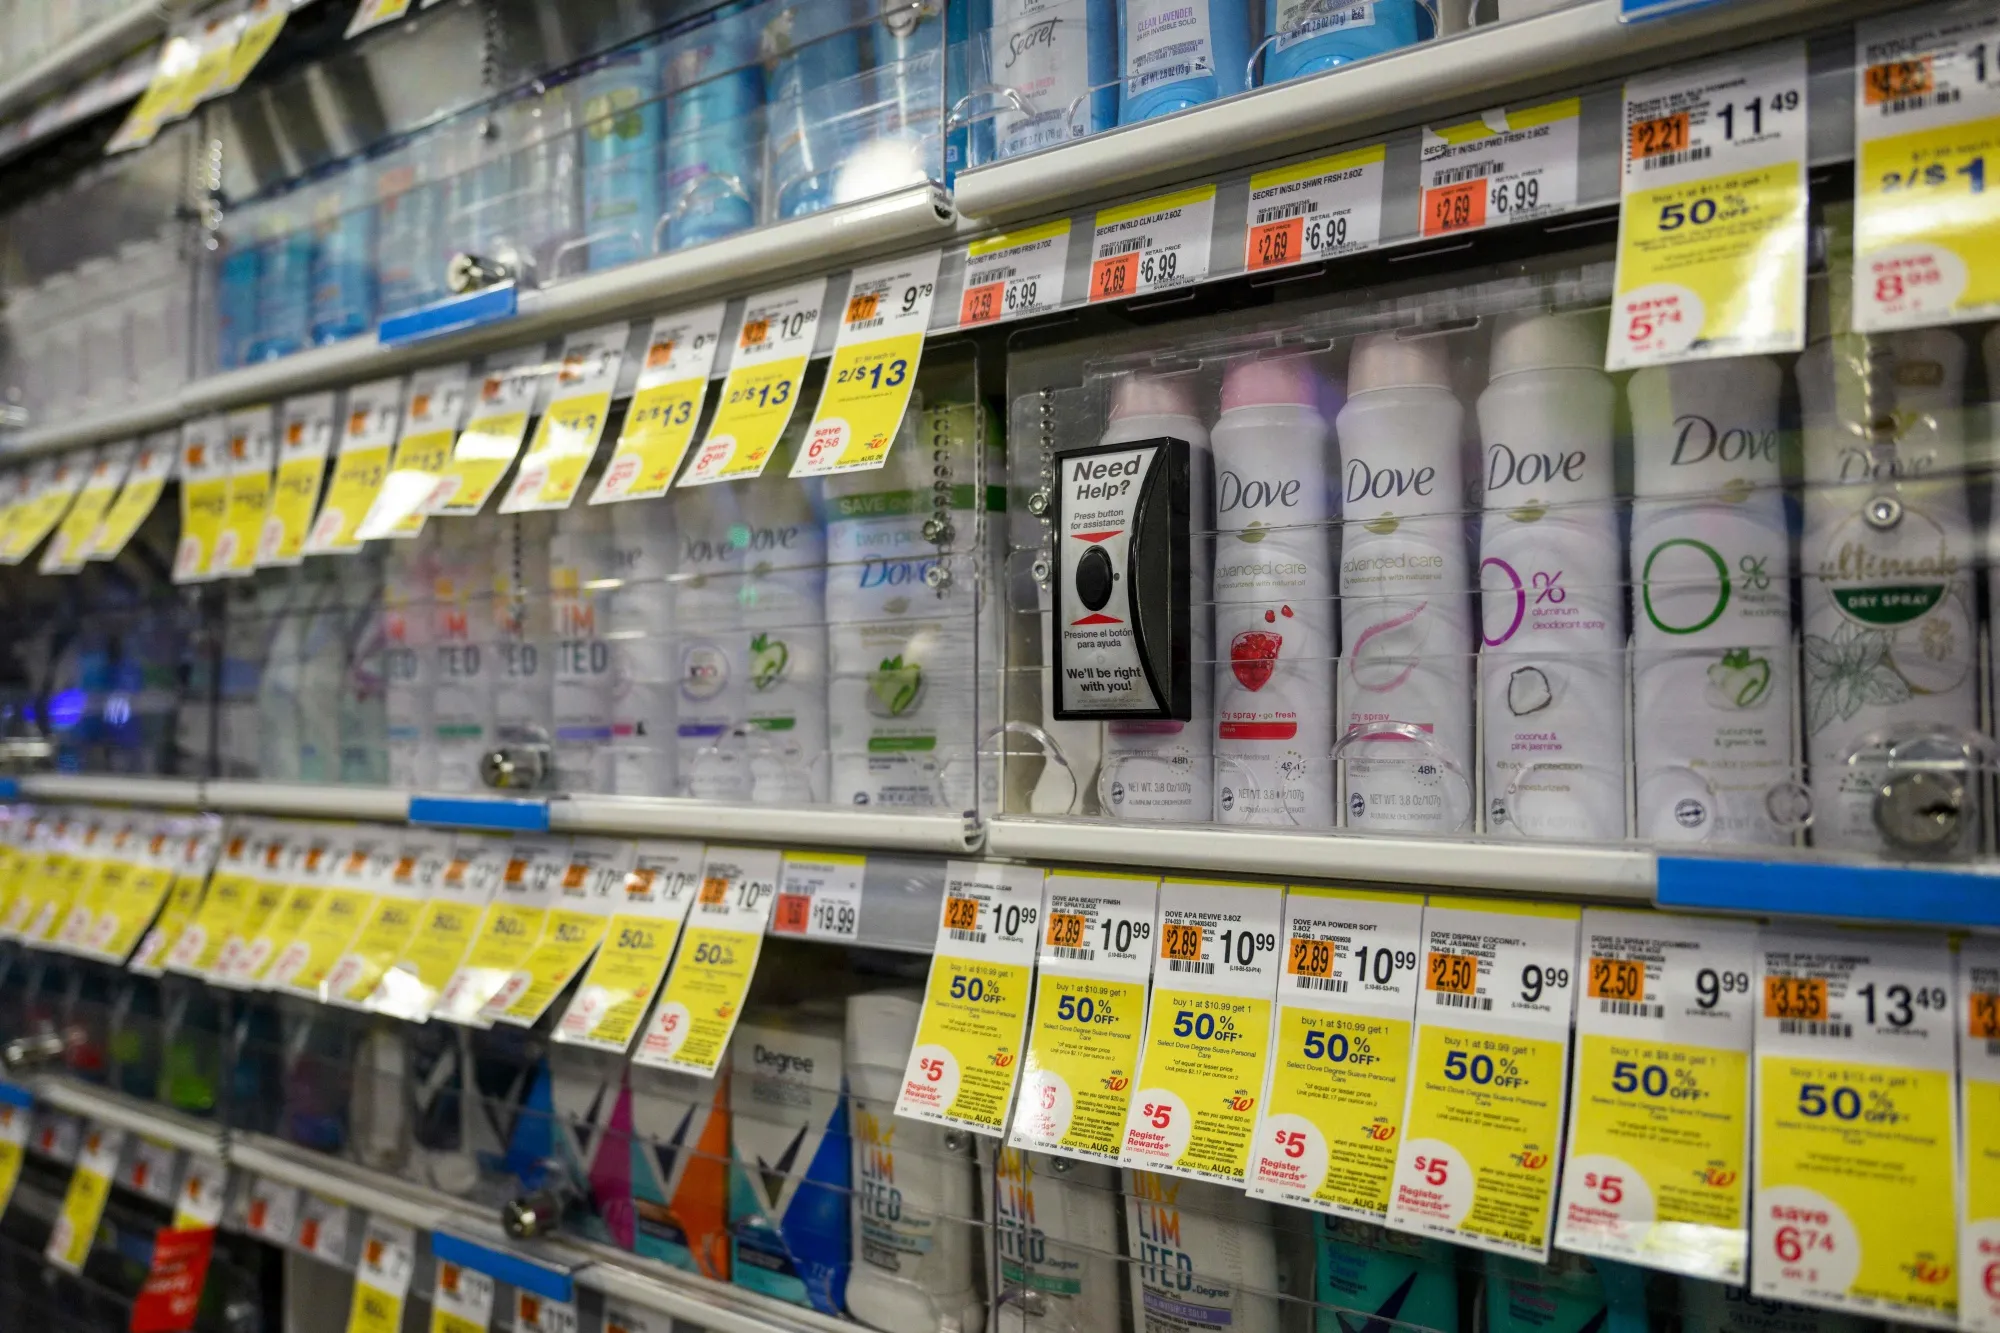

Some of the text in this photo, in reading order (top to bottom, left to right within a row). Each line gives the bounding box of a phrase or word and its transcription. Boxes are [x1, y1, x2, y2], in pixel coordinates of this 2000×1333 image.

[1138, 7, 1193, 33] CLEAN LAVENDER
[1151, 18, 1197, 36] INVISIBLE SOLID
[1252, 169, 1362, 201] SECRET IN/SLD SHWR FRSH 2.6OZ
[1491, 178, 1538, 214] $6.99
[1437, 195, 1469, 229] $2.69
[1096, 209, 1182, 237] SECRET IN/SLD CLN LAV 2.6OZ
[1306, 217, 1346, 251] $6.99
[1259, 231, 1287, 261] $2.69
[1141, 252, 1176, 283] $6.99
[1100, 265, 1126, 293] $2.69
[1005, 282, 1037, 310] $6.99
[814, 426, 841, 437] save
[1671, 413, 1778, 466] Dove
[861, 455, 875, 463] AUG
[1073, 455, 1141, 482] Need
[1488, 443, 1586, 491] Dove
[1076, 480, 1130, 501] Help?
[1347, 459, 1435, 503] Dove
[1220, 471, 1301, 513] Dove
[839, 498, 885, 515] SAVE
[1098, 509, 1123, 517] button
[1083, 519, 1125, 528] assistance
[1216, 561, 1307, 578] advanced care
[1343, 554, 1442, 573] advanced care
[1848, 593, 1929, 608] DRY SPRAY
[1064, 631, 1098, 639] Presione
[1109, 628, 1133, 637] botón
[1077, 640, 1121, 649] para ayuda
[1066, 667, 1141, 679] We'll be right
[1081, 682, 1132, 693] with you!
[1233, 712, 1256, 721] spray
[1172, 756, 1188, 764] 48h
[1418, 765, 1436, 775] 48h
[814, 903, 855, 934] $19.99
[949, 901, 974, 926] $2.89
[1053, 918, 1080, 943] $2.89
[1328, 921, 1357, 929] POWDER
[1167, 929, 1197, 957] $2.89
[1431, 931, 1520, 946] DOVE DSPRAY COCONUT
[1449, 940, 1479, 948] JASMINE
[1295, 945, 1328, 973] $2.89
[1432, 958, 1471, 990] $2.50
[1594, 964, 1638, 996] $2.50
[1173, 998, 1187, 1007] buy
[1204, 1001, 1230, 1010] $10.99
[1232, 1004, 1244, 1013] get
[755, 1044, 814, 1074] Degree
[920, 1058, 944, 1081] $5
[908, 1081, 937, 1092] Register
[974, 1114, 992, 1124] AUG
[1144, 1103, 1172, 1129] $5
[1130, 1129, 1165, 1142] Register
[1275, 1130, 1306, 1158] $5
[1090, 1142, 1120, 1154] AUG 26
[1178, 1159, 1243, 1176] Good thru AUG 26
[1261, 1158, 1300, 1172] Register
[1414, 1156, 1448, 1186] $5
[1400, 1185, 1443, 1200] Register
[1585, 1172, 1622, 1205] $5
[1353, 1198, 1387, 1212] AUG 26
[1137, 1201, 1181, 1248] LIM
[1771, 1206, 1829, 1226] save
[1140, 1241, 1192, 1292] ITED
[1196, 1285, 1229, 1297] Degree
[1188, 1310, 1207, 1319] SOLID
